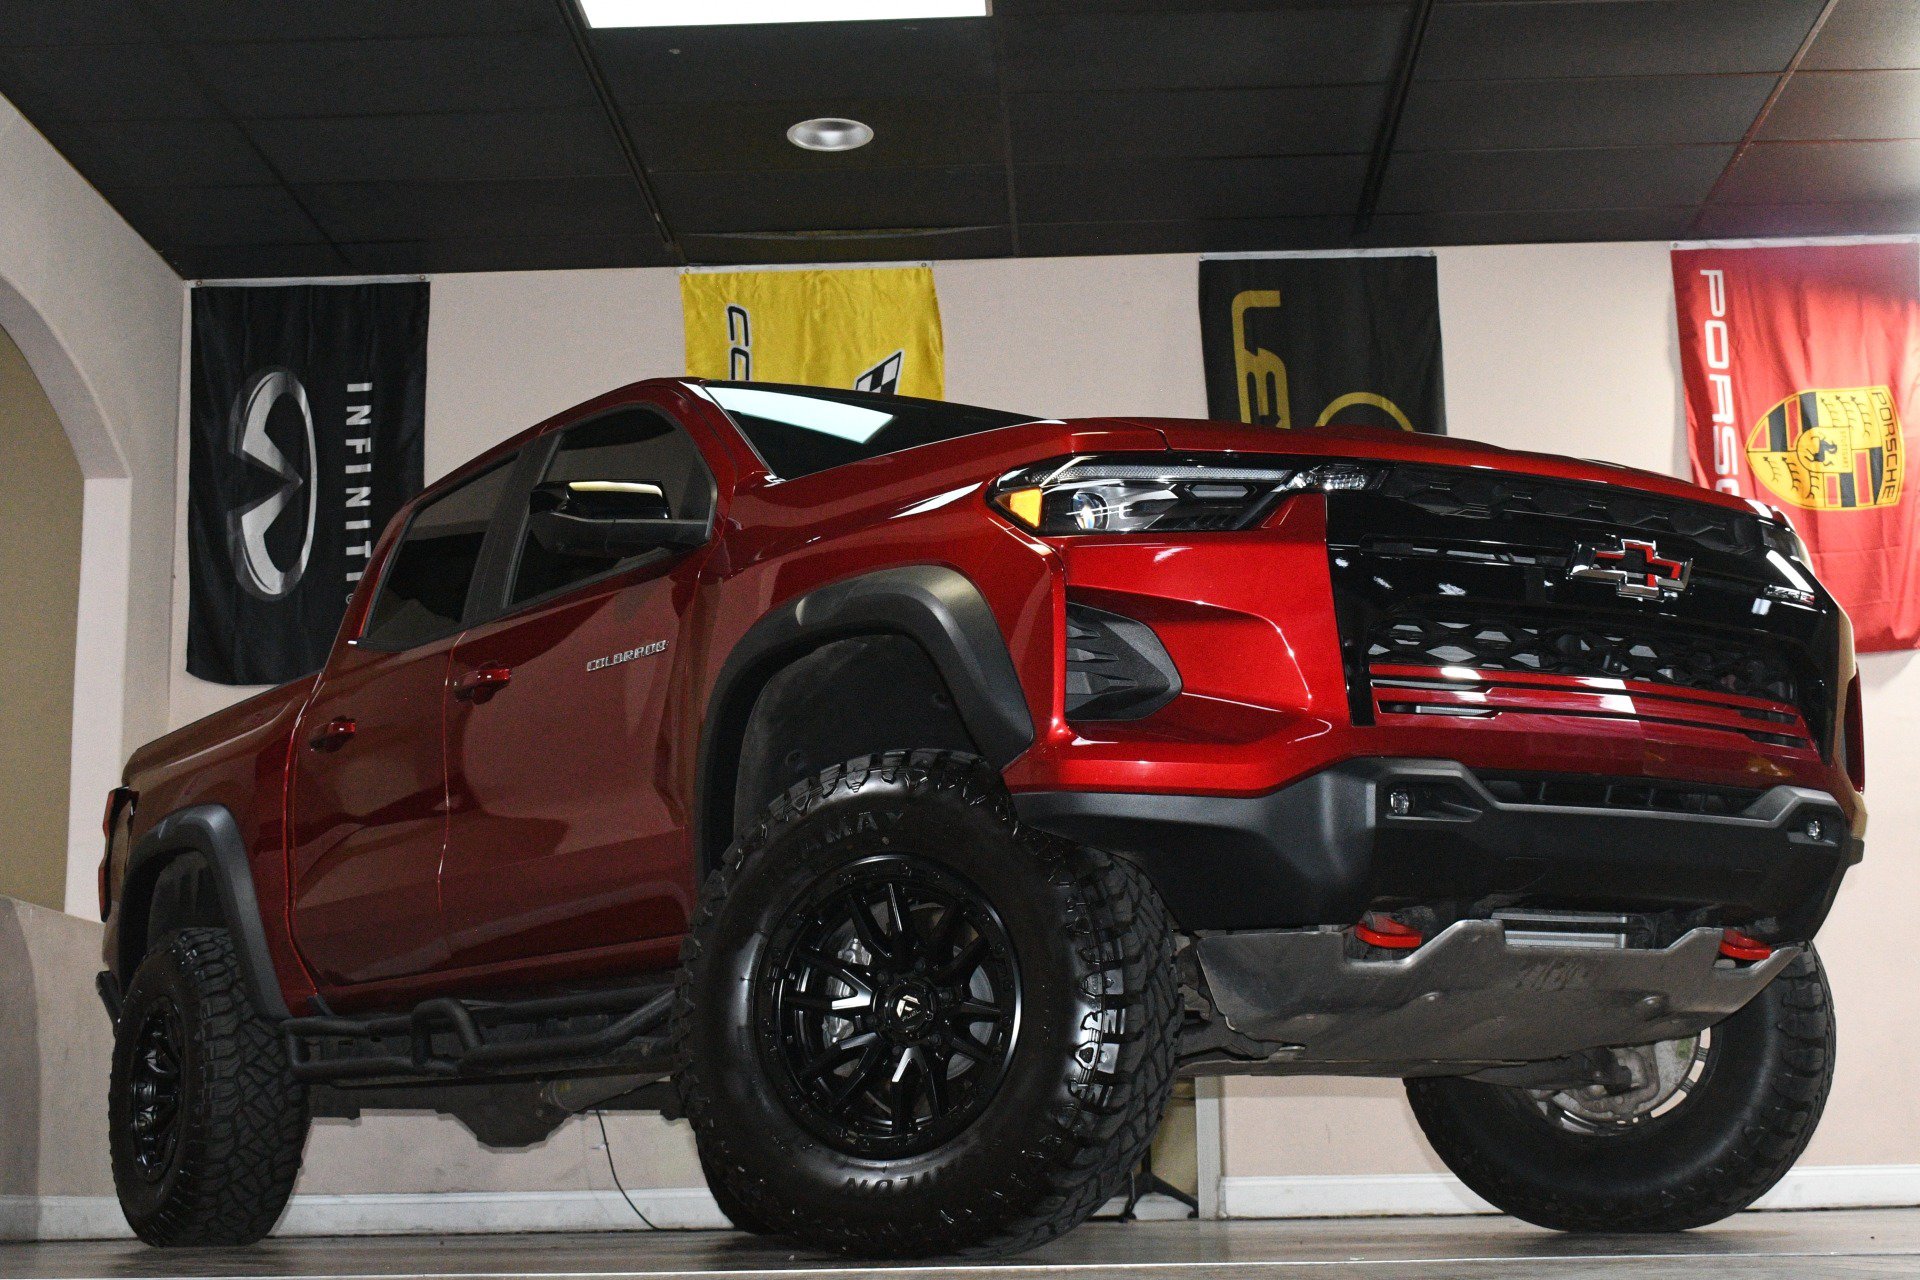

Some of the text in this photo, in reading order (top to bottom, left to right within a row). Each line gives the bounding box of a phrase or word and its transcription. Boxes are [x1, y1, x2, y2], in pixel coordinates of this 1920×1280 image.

[345, 382, 373, 582] INFINITI
[1871, 391, 1898, 499] PORSCHE
[586, 640, 667, 671] COLORADO
